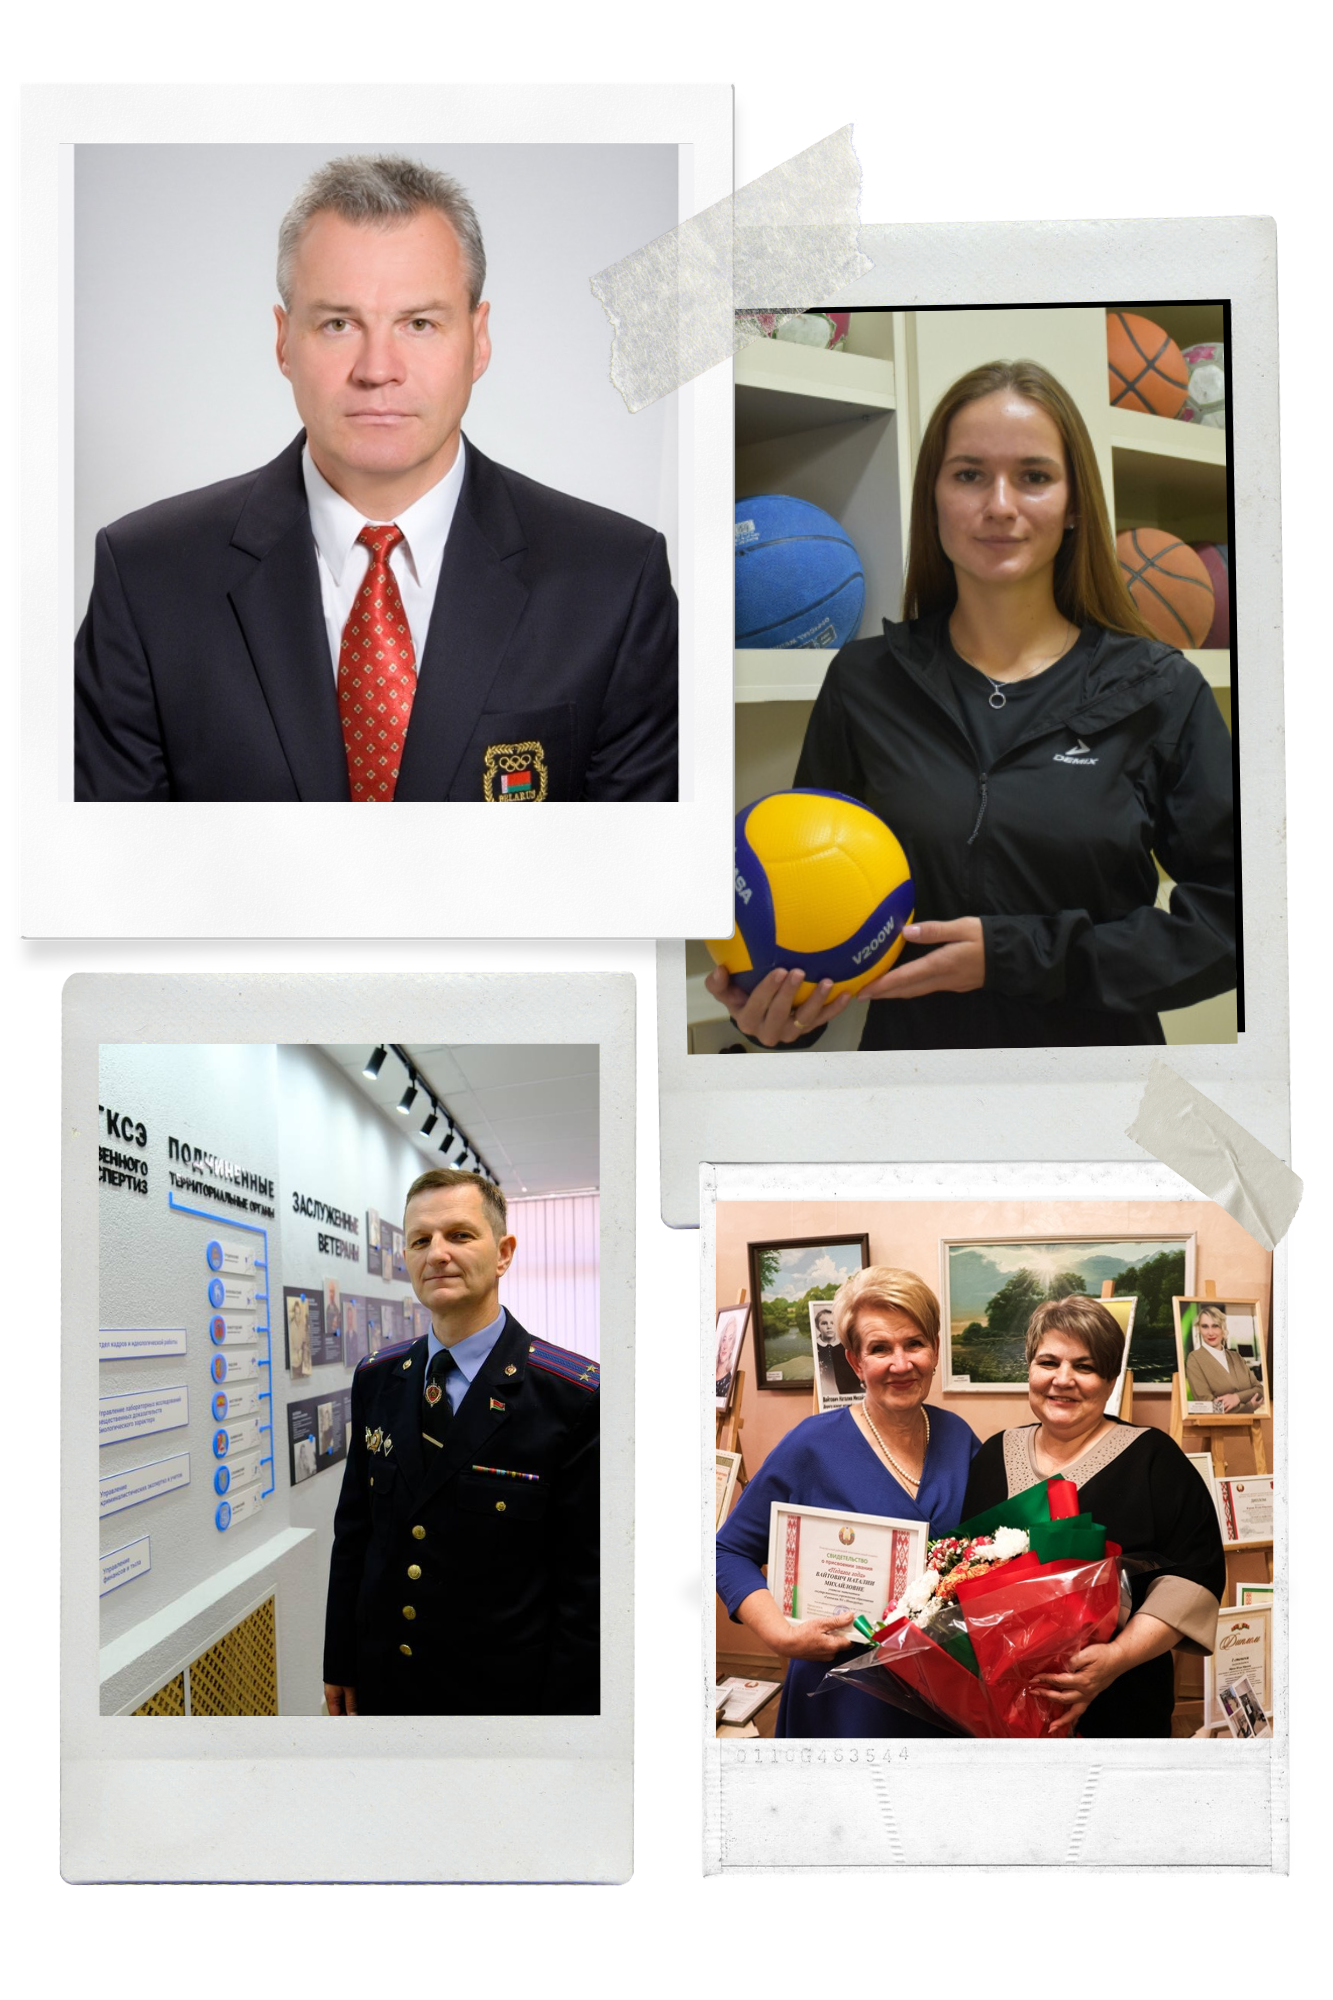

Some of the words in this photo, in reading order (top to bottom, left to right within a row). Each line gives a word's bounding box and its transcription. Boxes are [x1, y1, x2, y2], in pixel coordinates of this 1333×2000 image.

[1053, 754, 1099, 765] DEMIX
[852, 916, 894, 964] V200W
[168, 1136, 275, 1199] ПОДЧИНЕННЫЕ
[169, 1171, 248, 1210] ТЕРРИТОРИАЛЬНЫЕ
[292, 1191, 359, 1235] ЗАСЛУЖЕННЫЕ
[317, 1232, 360, 1262] ВЕТЕРАНЫ
